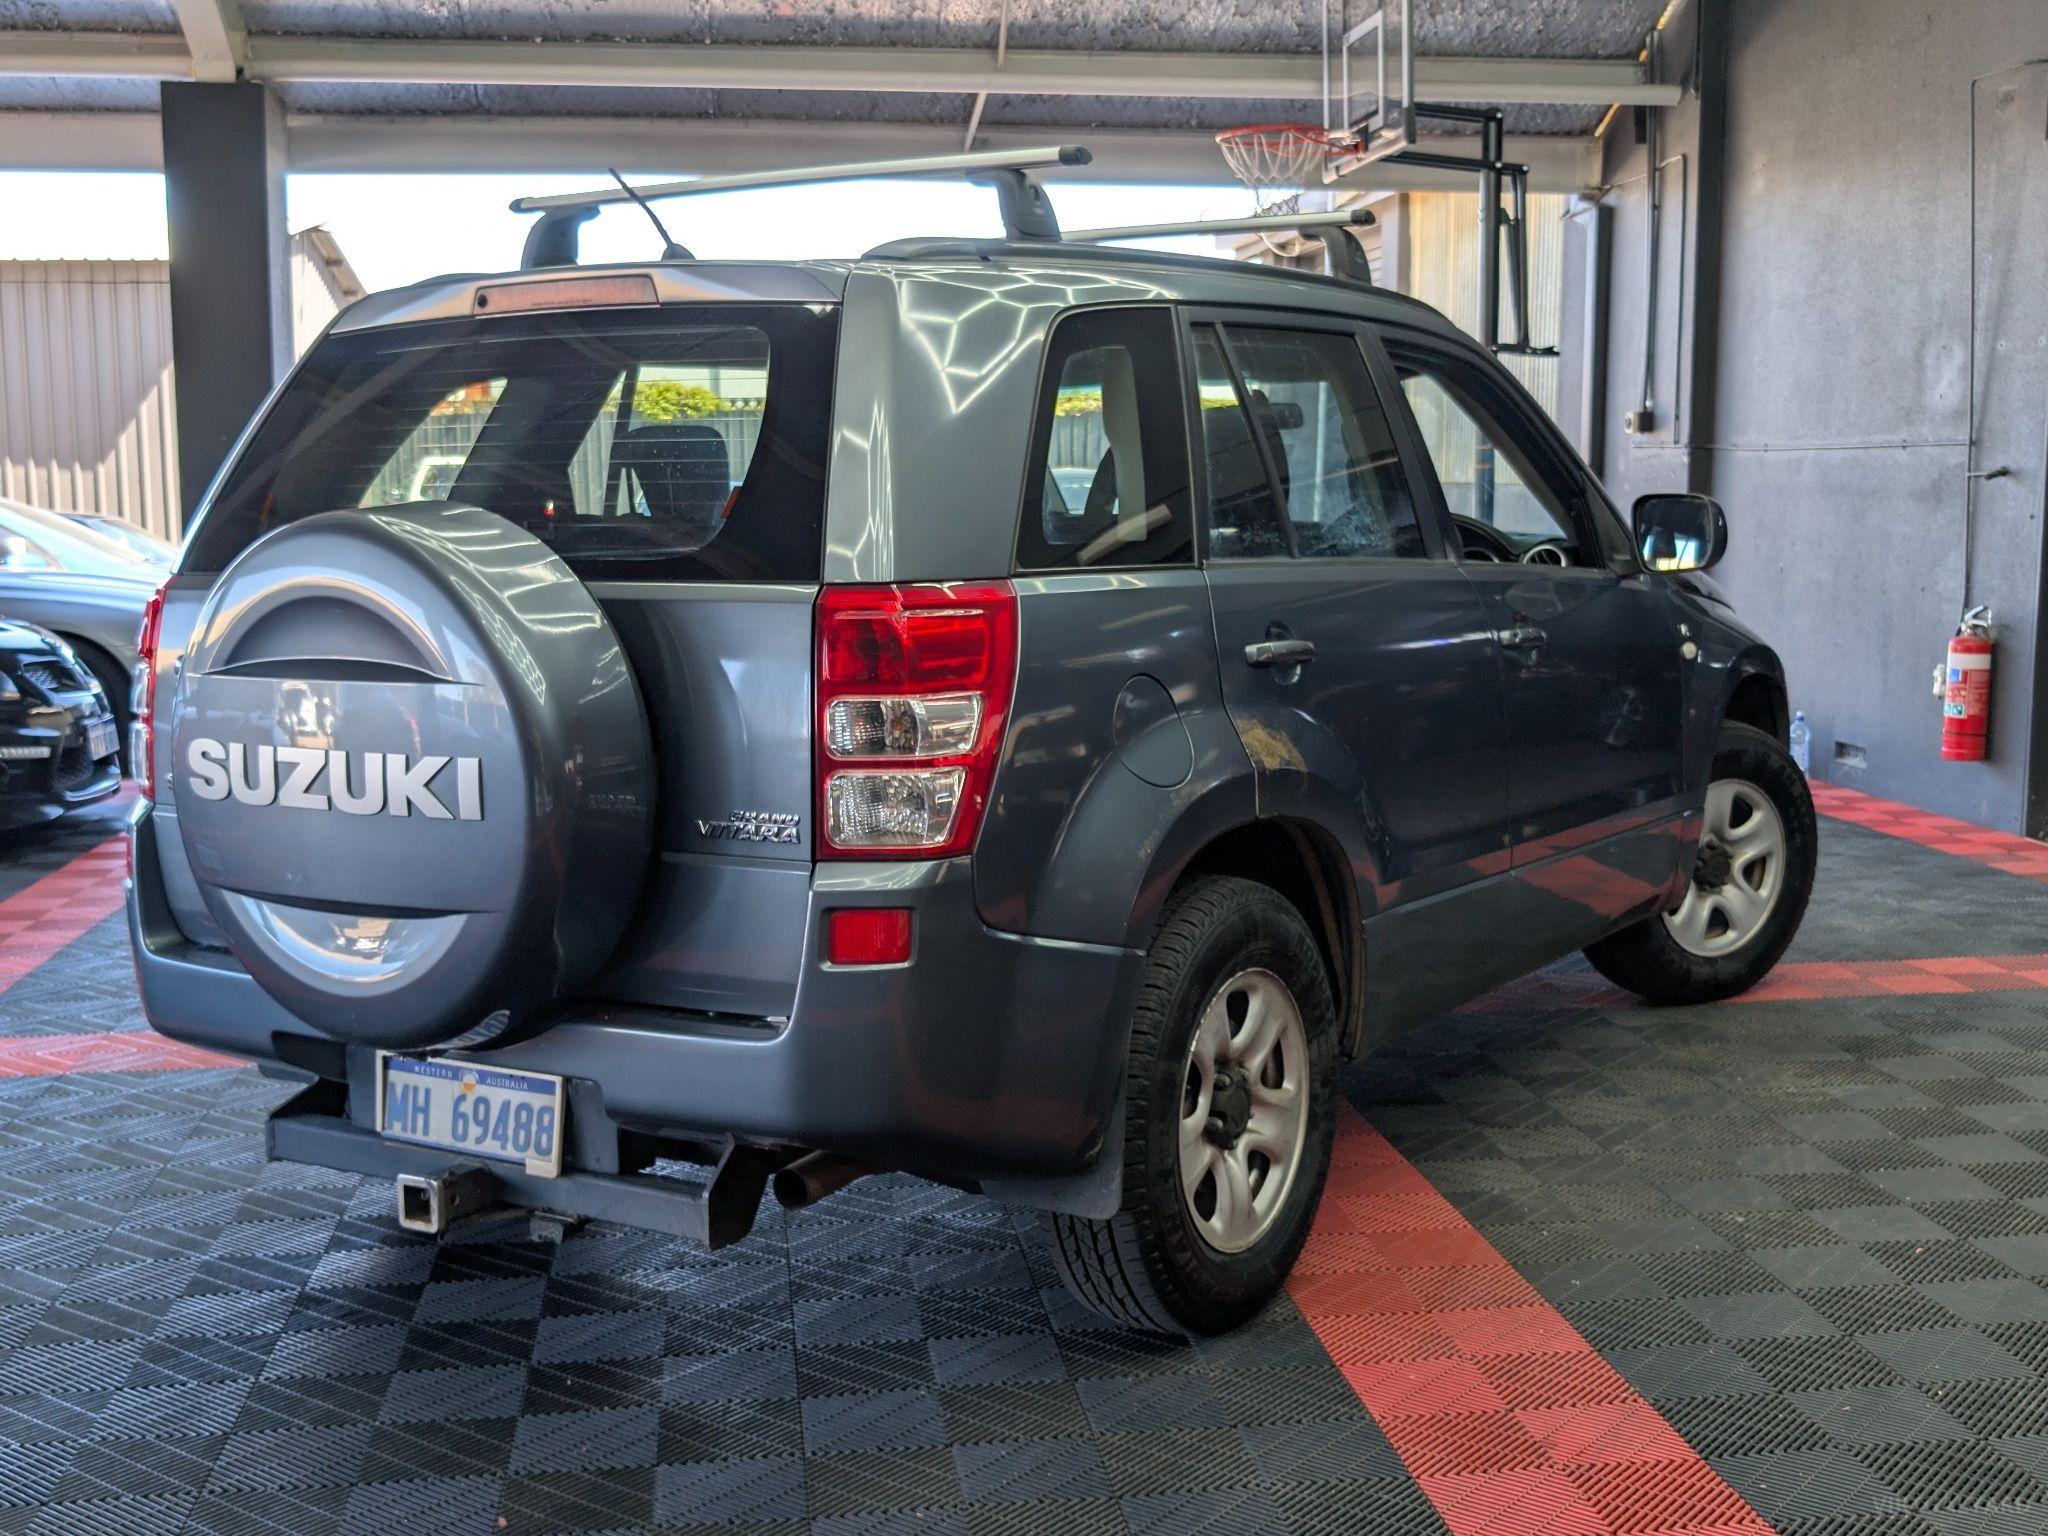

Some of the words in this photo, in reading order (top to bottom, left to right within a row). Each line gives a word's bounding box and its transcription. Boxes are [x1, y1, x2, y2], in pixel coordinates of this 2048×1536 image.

[188, 738, 484, 821] SUZUKI
[697, 819, 801, 844] VITARA
[414, 1065, 453, 1079] WESTERN
[486, 1077, 529, 1091] AUSTRALIA
[386, 1082, 432, 1137] MH
[451, 1093, 555, 1157] 69488
